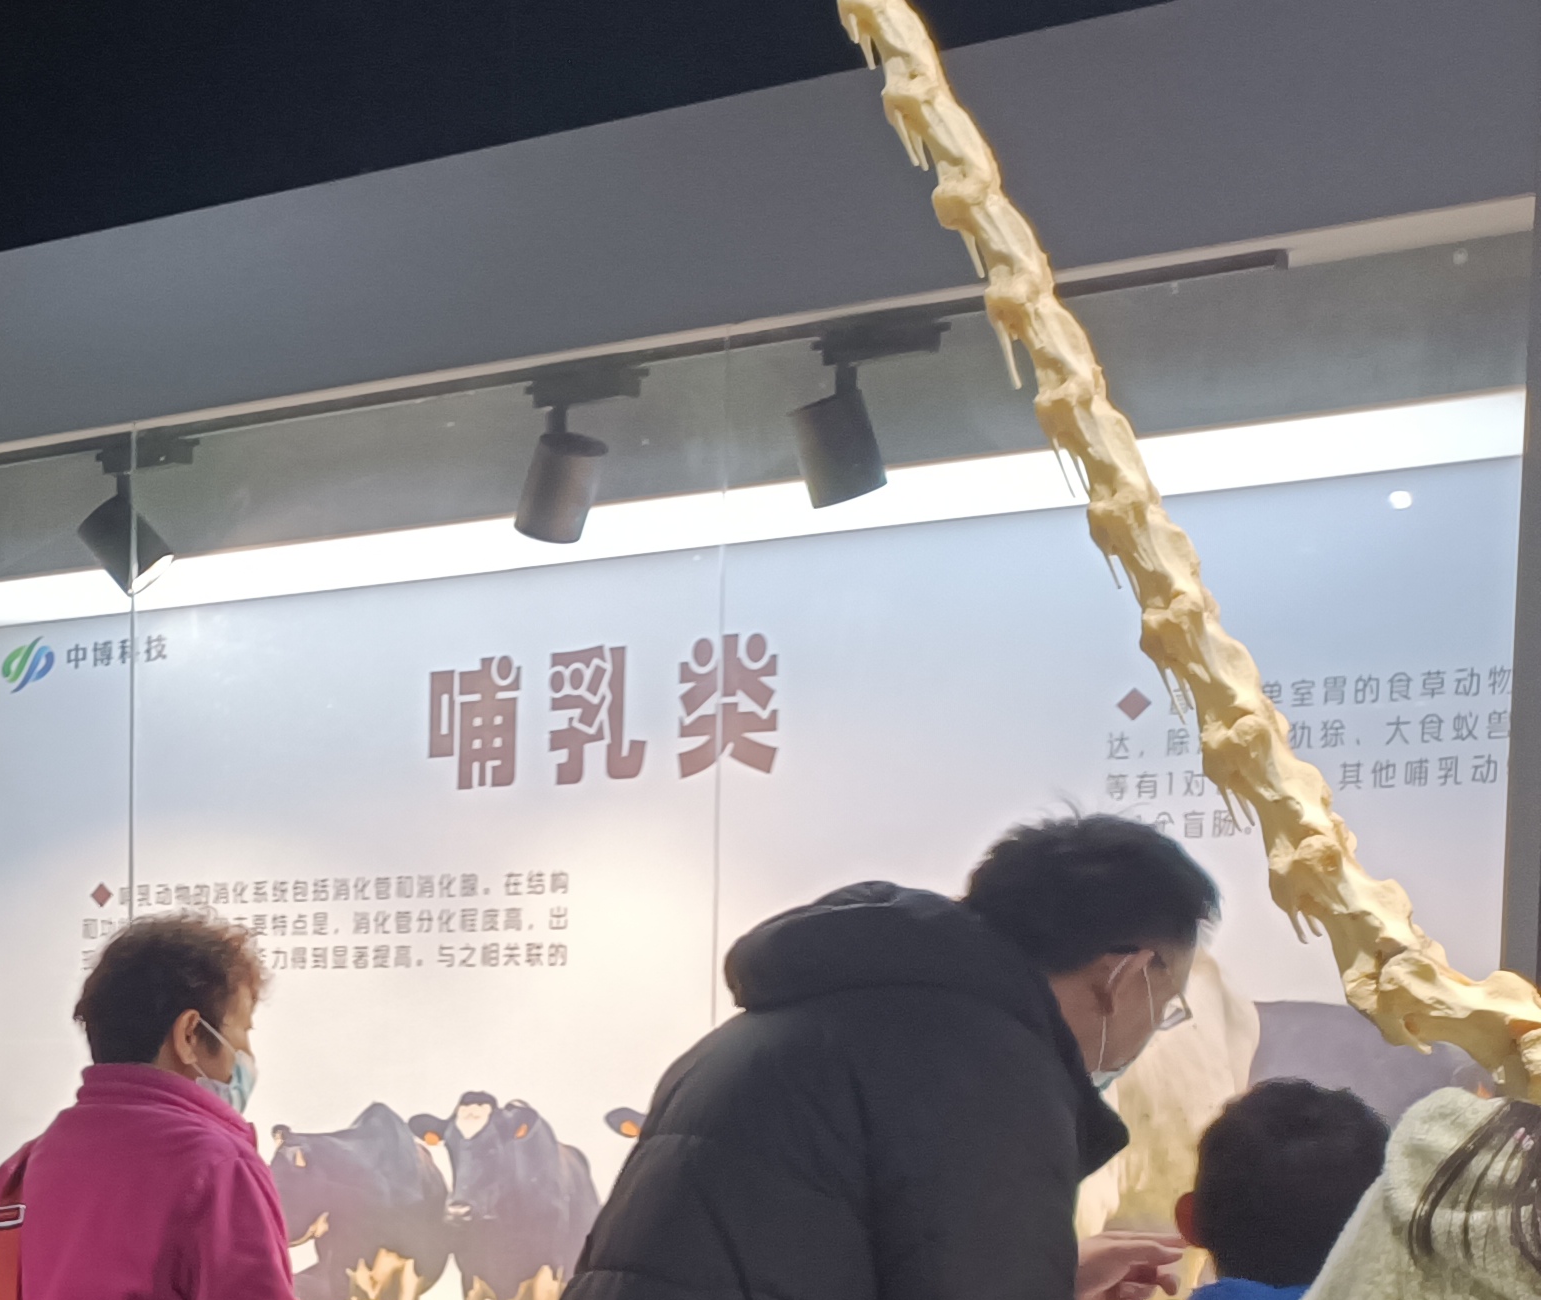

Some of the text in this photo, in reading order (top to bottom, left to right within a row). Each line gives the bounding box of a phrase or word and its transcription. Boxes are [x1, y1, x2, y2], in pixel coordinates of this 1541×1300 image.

[66, 634, 168, 670] 中博科技
[429, 633, 779, 790] 哺乳类
[1106, 728, 1202, 760] 达，除
